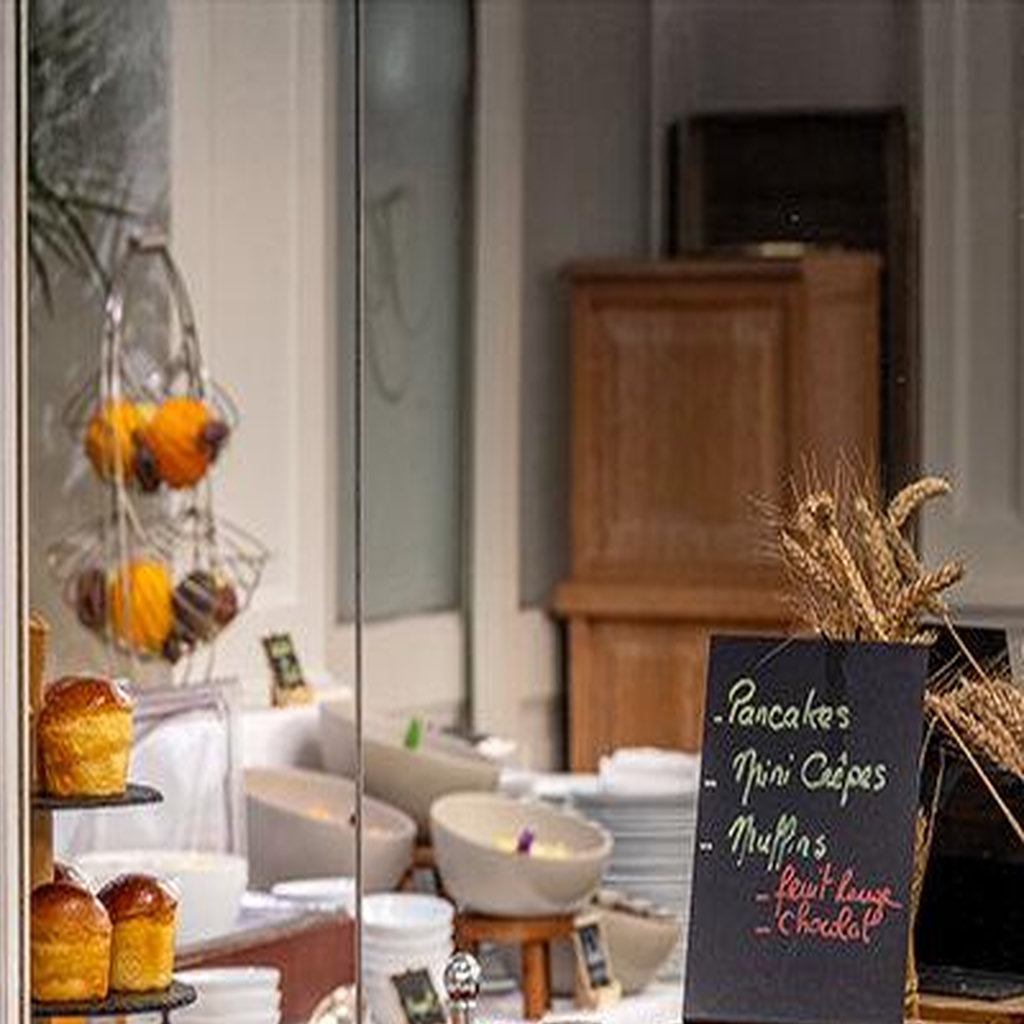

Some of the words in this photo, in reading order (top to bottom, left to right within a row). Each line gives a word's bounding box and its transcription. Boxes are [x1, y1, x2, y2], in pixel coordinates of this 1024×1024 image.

[728, 678, 851, 731] Pancakes
[732, 748, 795, 806] Mini
[728, 813, 827, 871] Muffins
